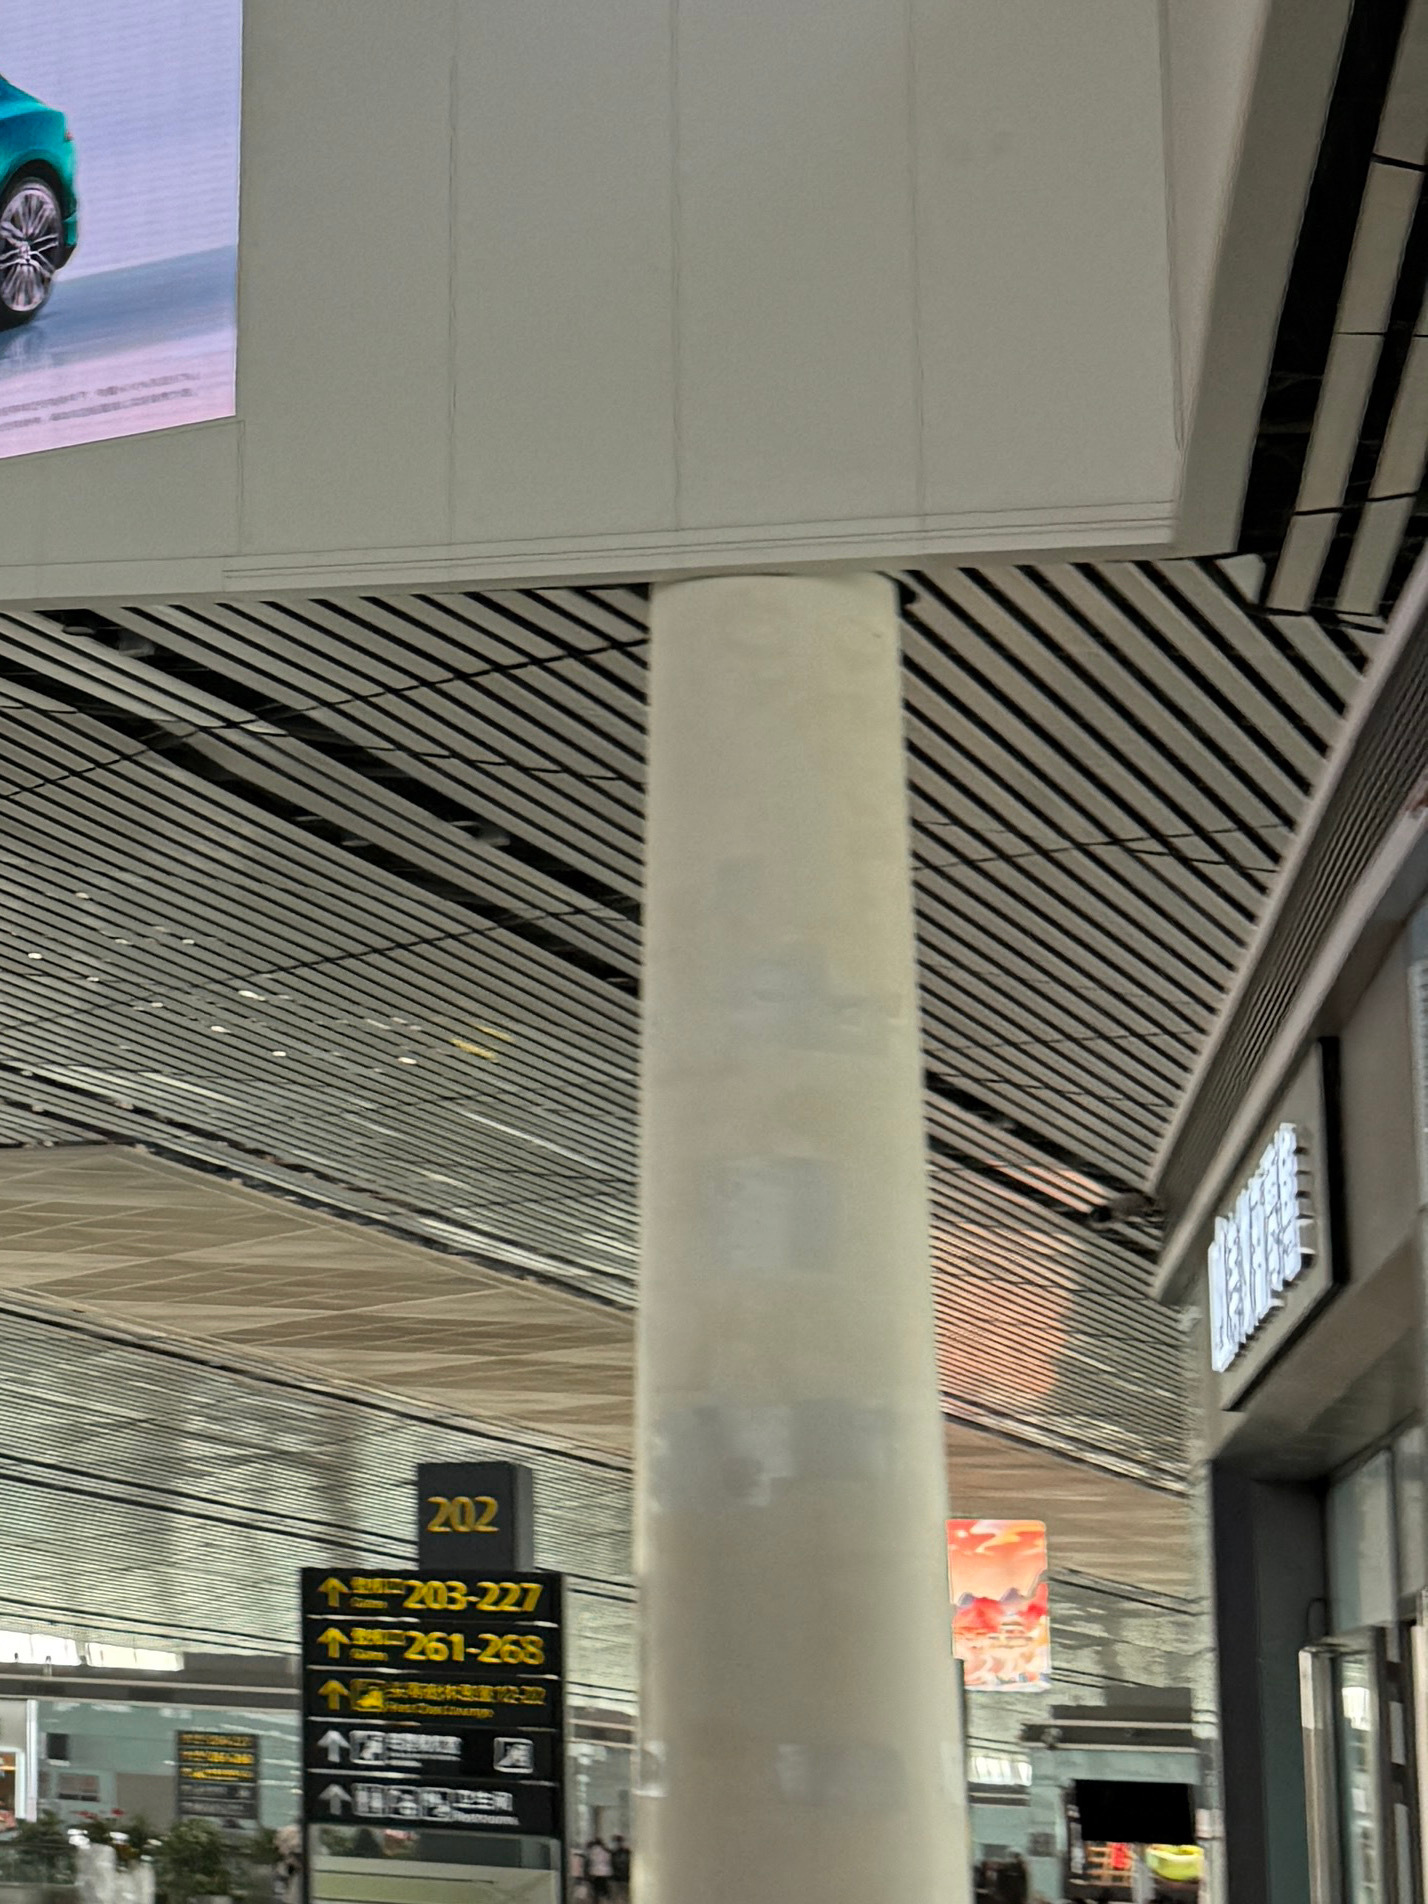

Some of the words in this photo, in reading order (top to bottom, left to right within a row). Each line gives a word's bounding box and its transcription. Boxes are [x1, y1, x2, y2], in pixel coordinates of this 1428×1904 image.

[426, 1496, 501, 1534] 202
[402, 1580, 544, 1613] 203-227
[403, 1631, 545, 1666] 261-268
